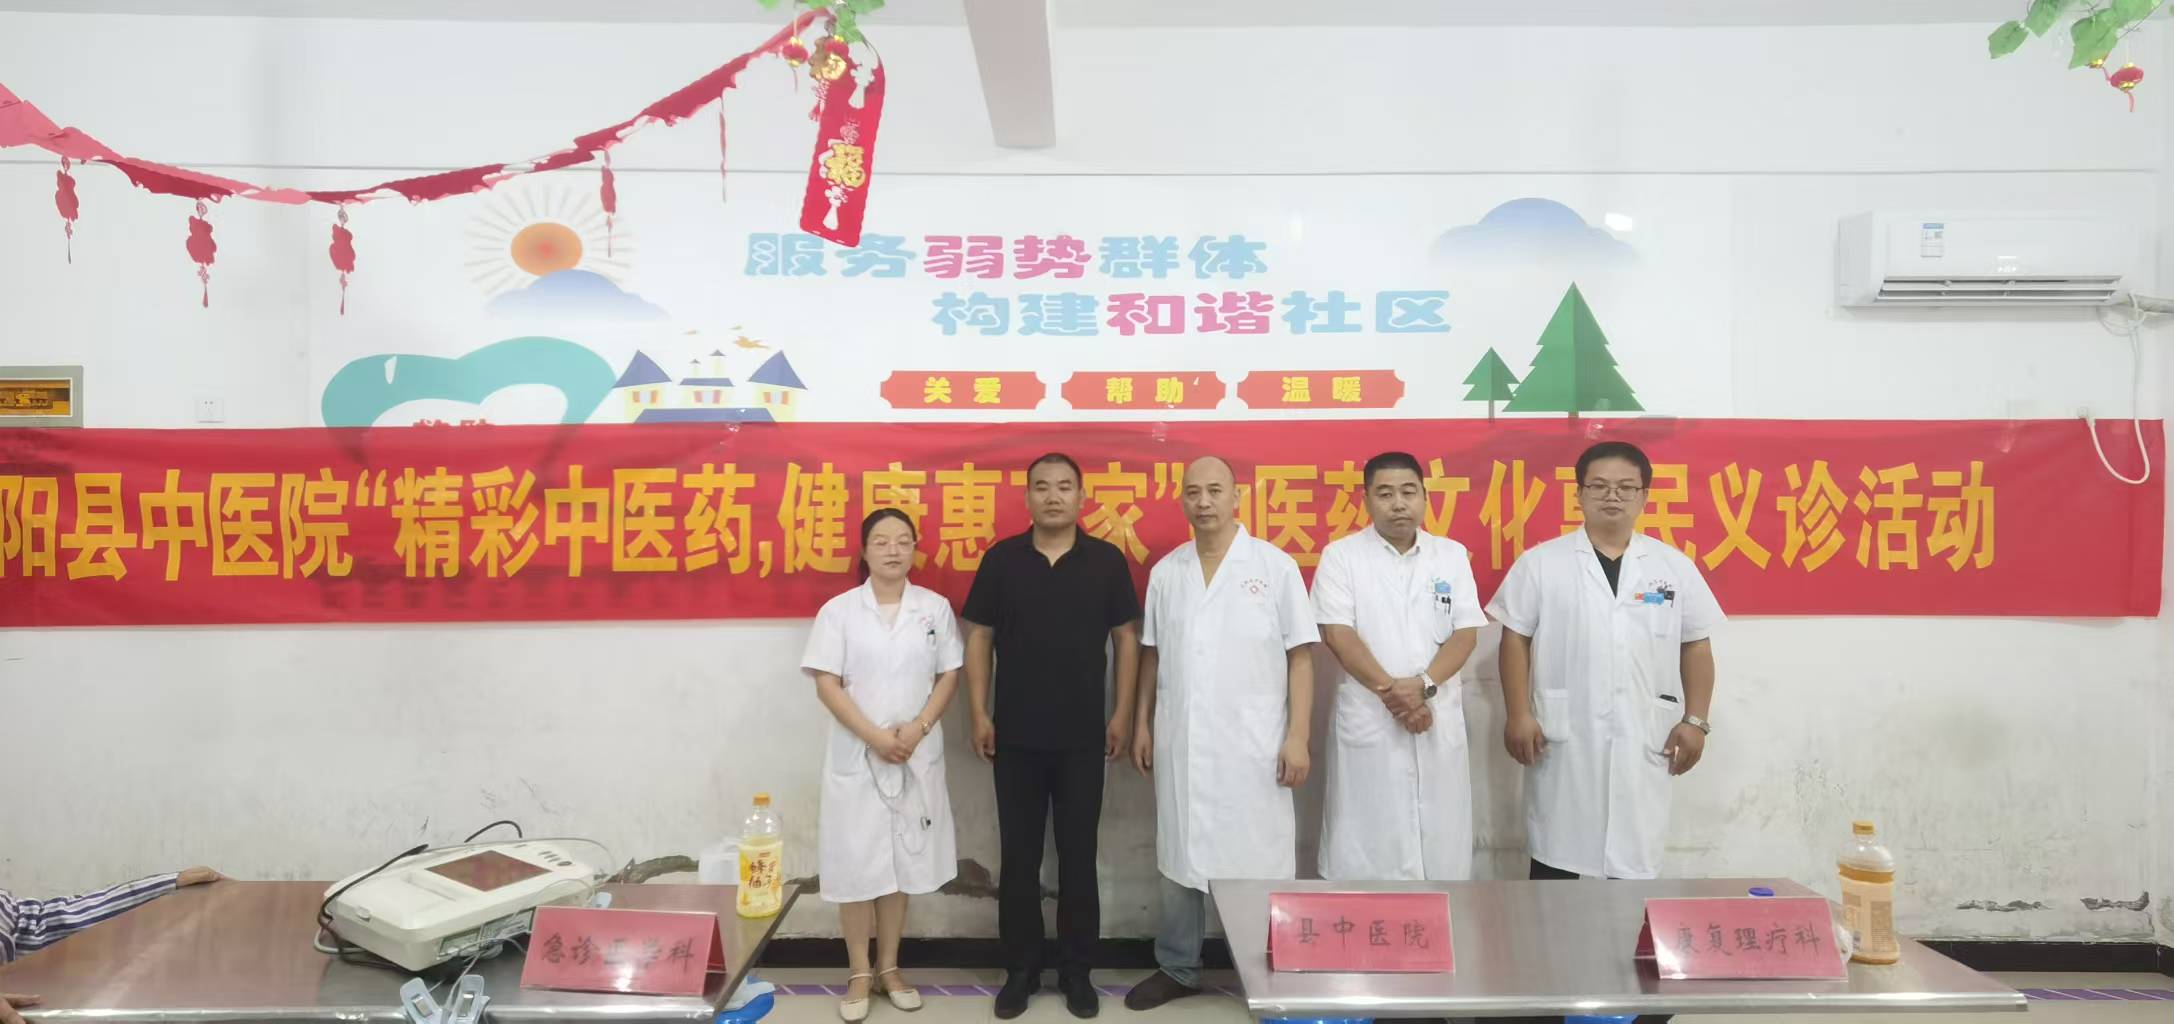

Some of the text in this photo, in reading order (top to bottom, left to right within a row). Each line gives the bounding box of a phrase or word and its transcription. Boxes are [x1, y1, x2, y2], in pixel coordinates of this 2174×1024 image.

[744, 233, 1268, 280] 服务弱势群体
[931, 290, 1452, 337] 构建和谐社区
[924, 376, 1002, 404] 关爱
[1106, 376, 1184, 404] 帮助
[1282, 375, 1362, 402] 温暖
[1297, 916, 1430, 950] 县中医院
